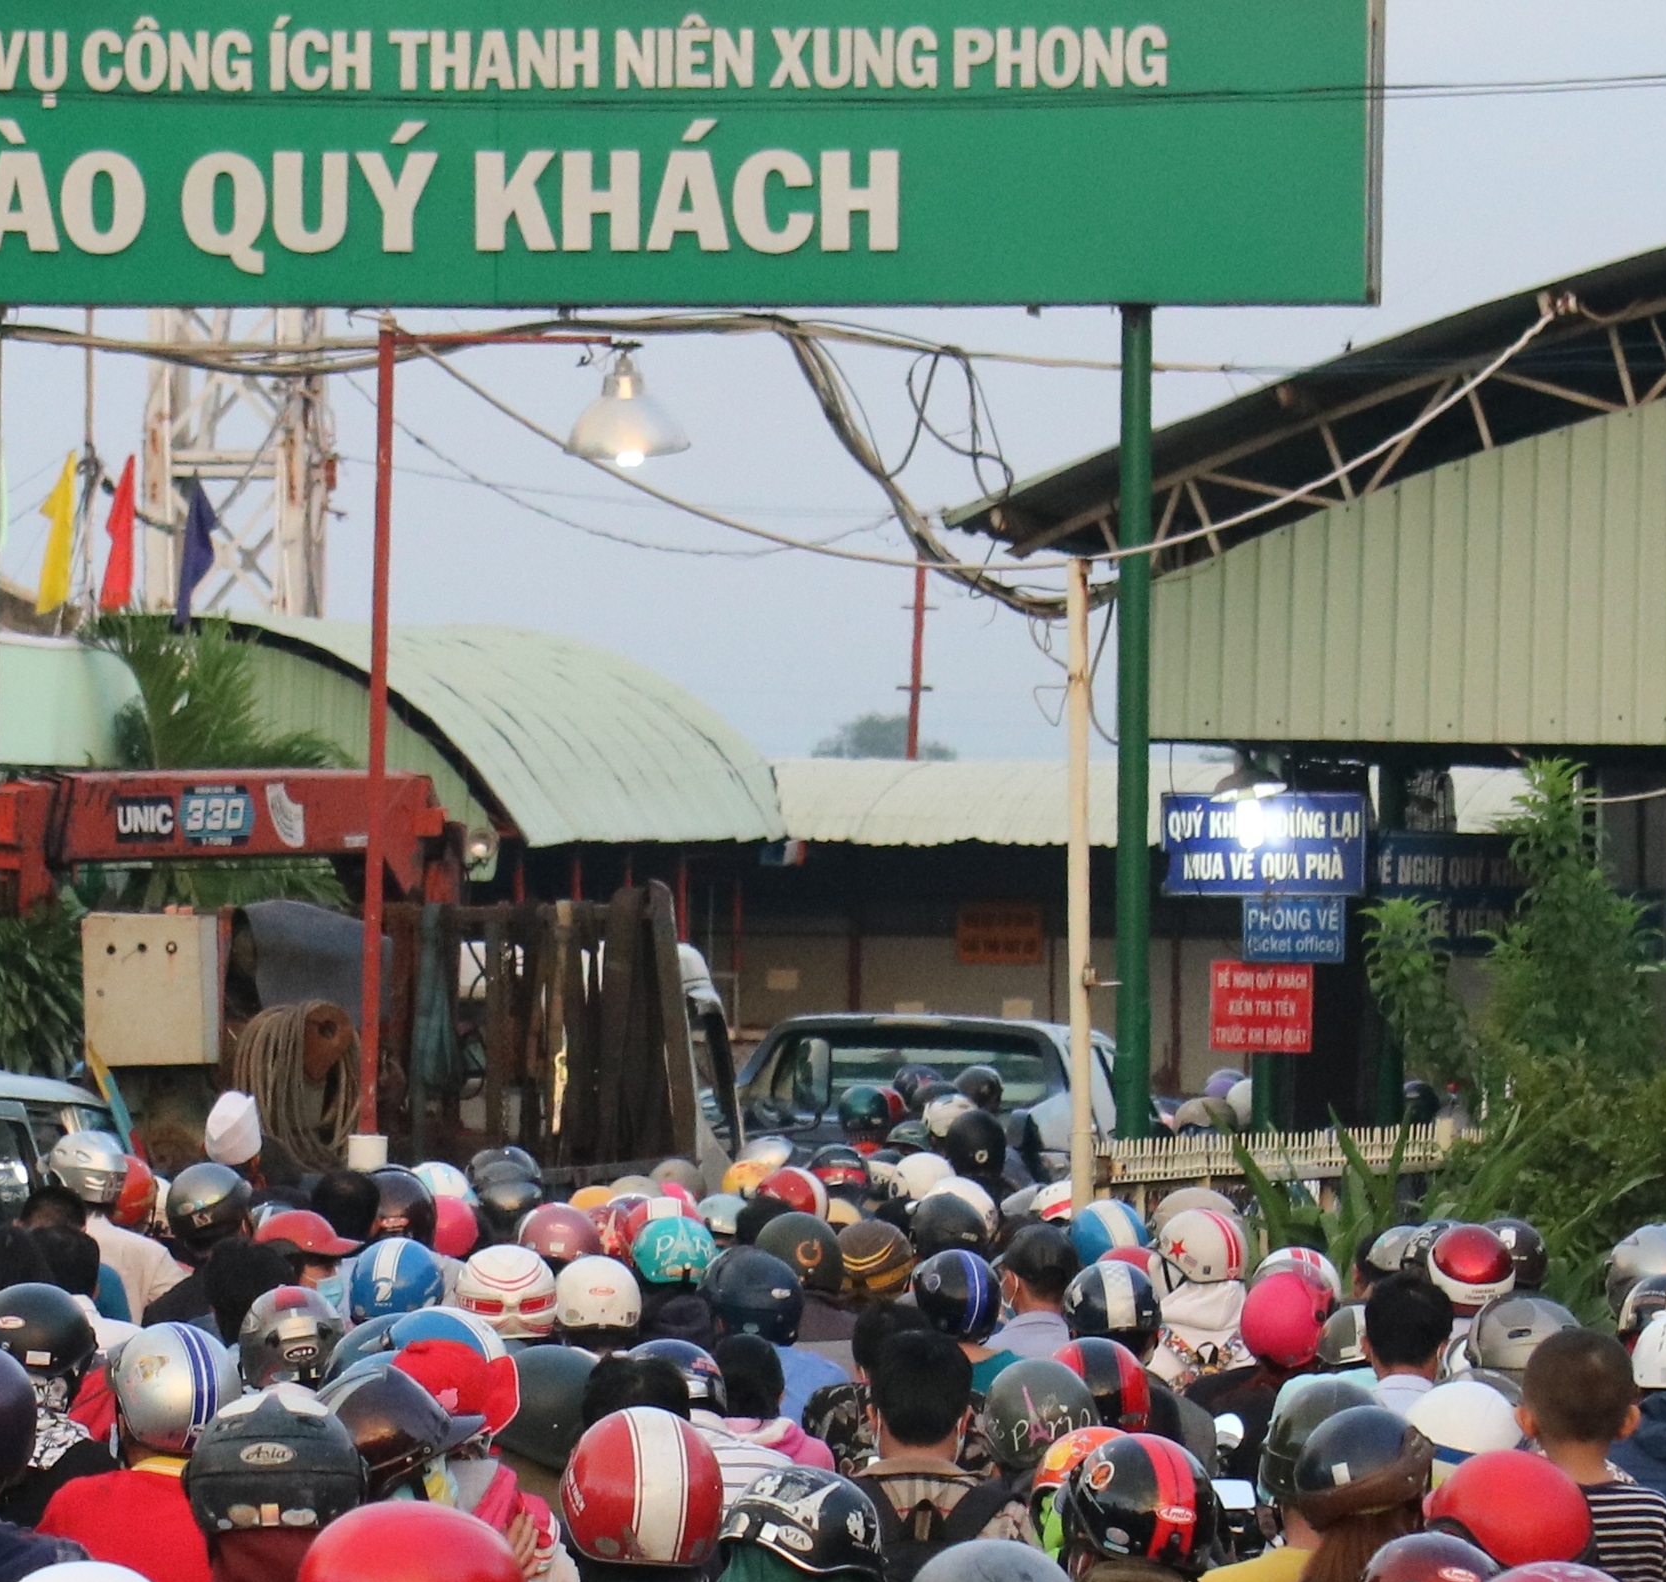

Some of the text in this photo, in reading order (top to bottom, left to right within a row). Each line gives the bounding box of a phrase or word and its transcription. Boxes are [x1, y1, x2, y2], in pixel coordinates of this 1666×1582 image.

[82, 13, 252, 91] CÔNG
[269, 14, 371, 91] ÍCH
[388, 28, 599, 90] THANH
[615, 13, 754, 89] NIÊN
[770, 26, 938, 89] XUNG
[953, 24, 1167, 88] PHONG
[182, 121, 437, 273] QUÝ
[475, 119, 899, 253] KHÁCH
[117, 798, 245, 834] UNIC 330
[1168, 804, 1204, 842] QUÝ
[1330, 811, 1360, 843] LẠI
[1183, 847, 1344, 884] MUA VÉ QUA PHÀ
[1317, 903, 1339, 931] VÉ
[1295, 934, 1340, 954] office)
[244, 1445, 289, 1464] Asia
[783, 1527, 807, 1548] VIA
